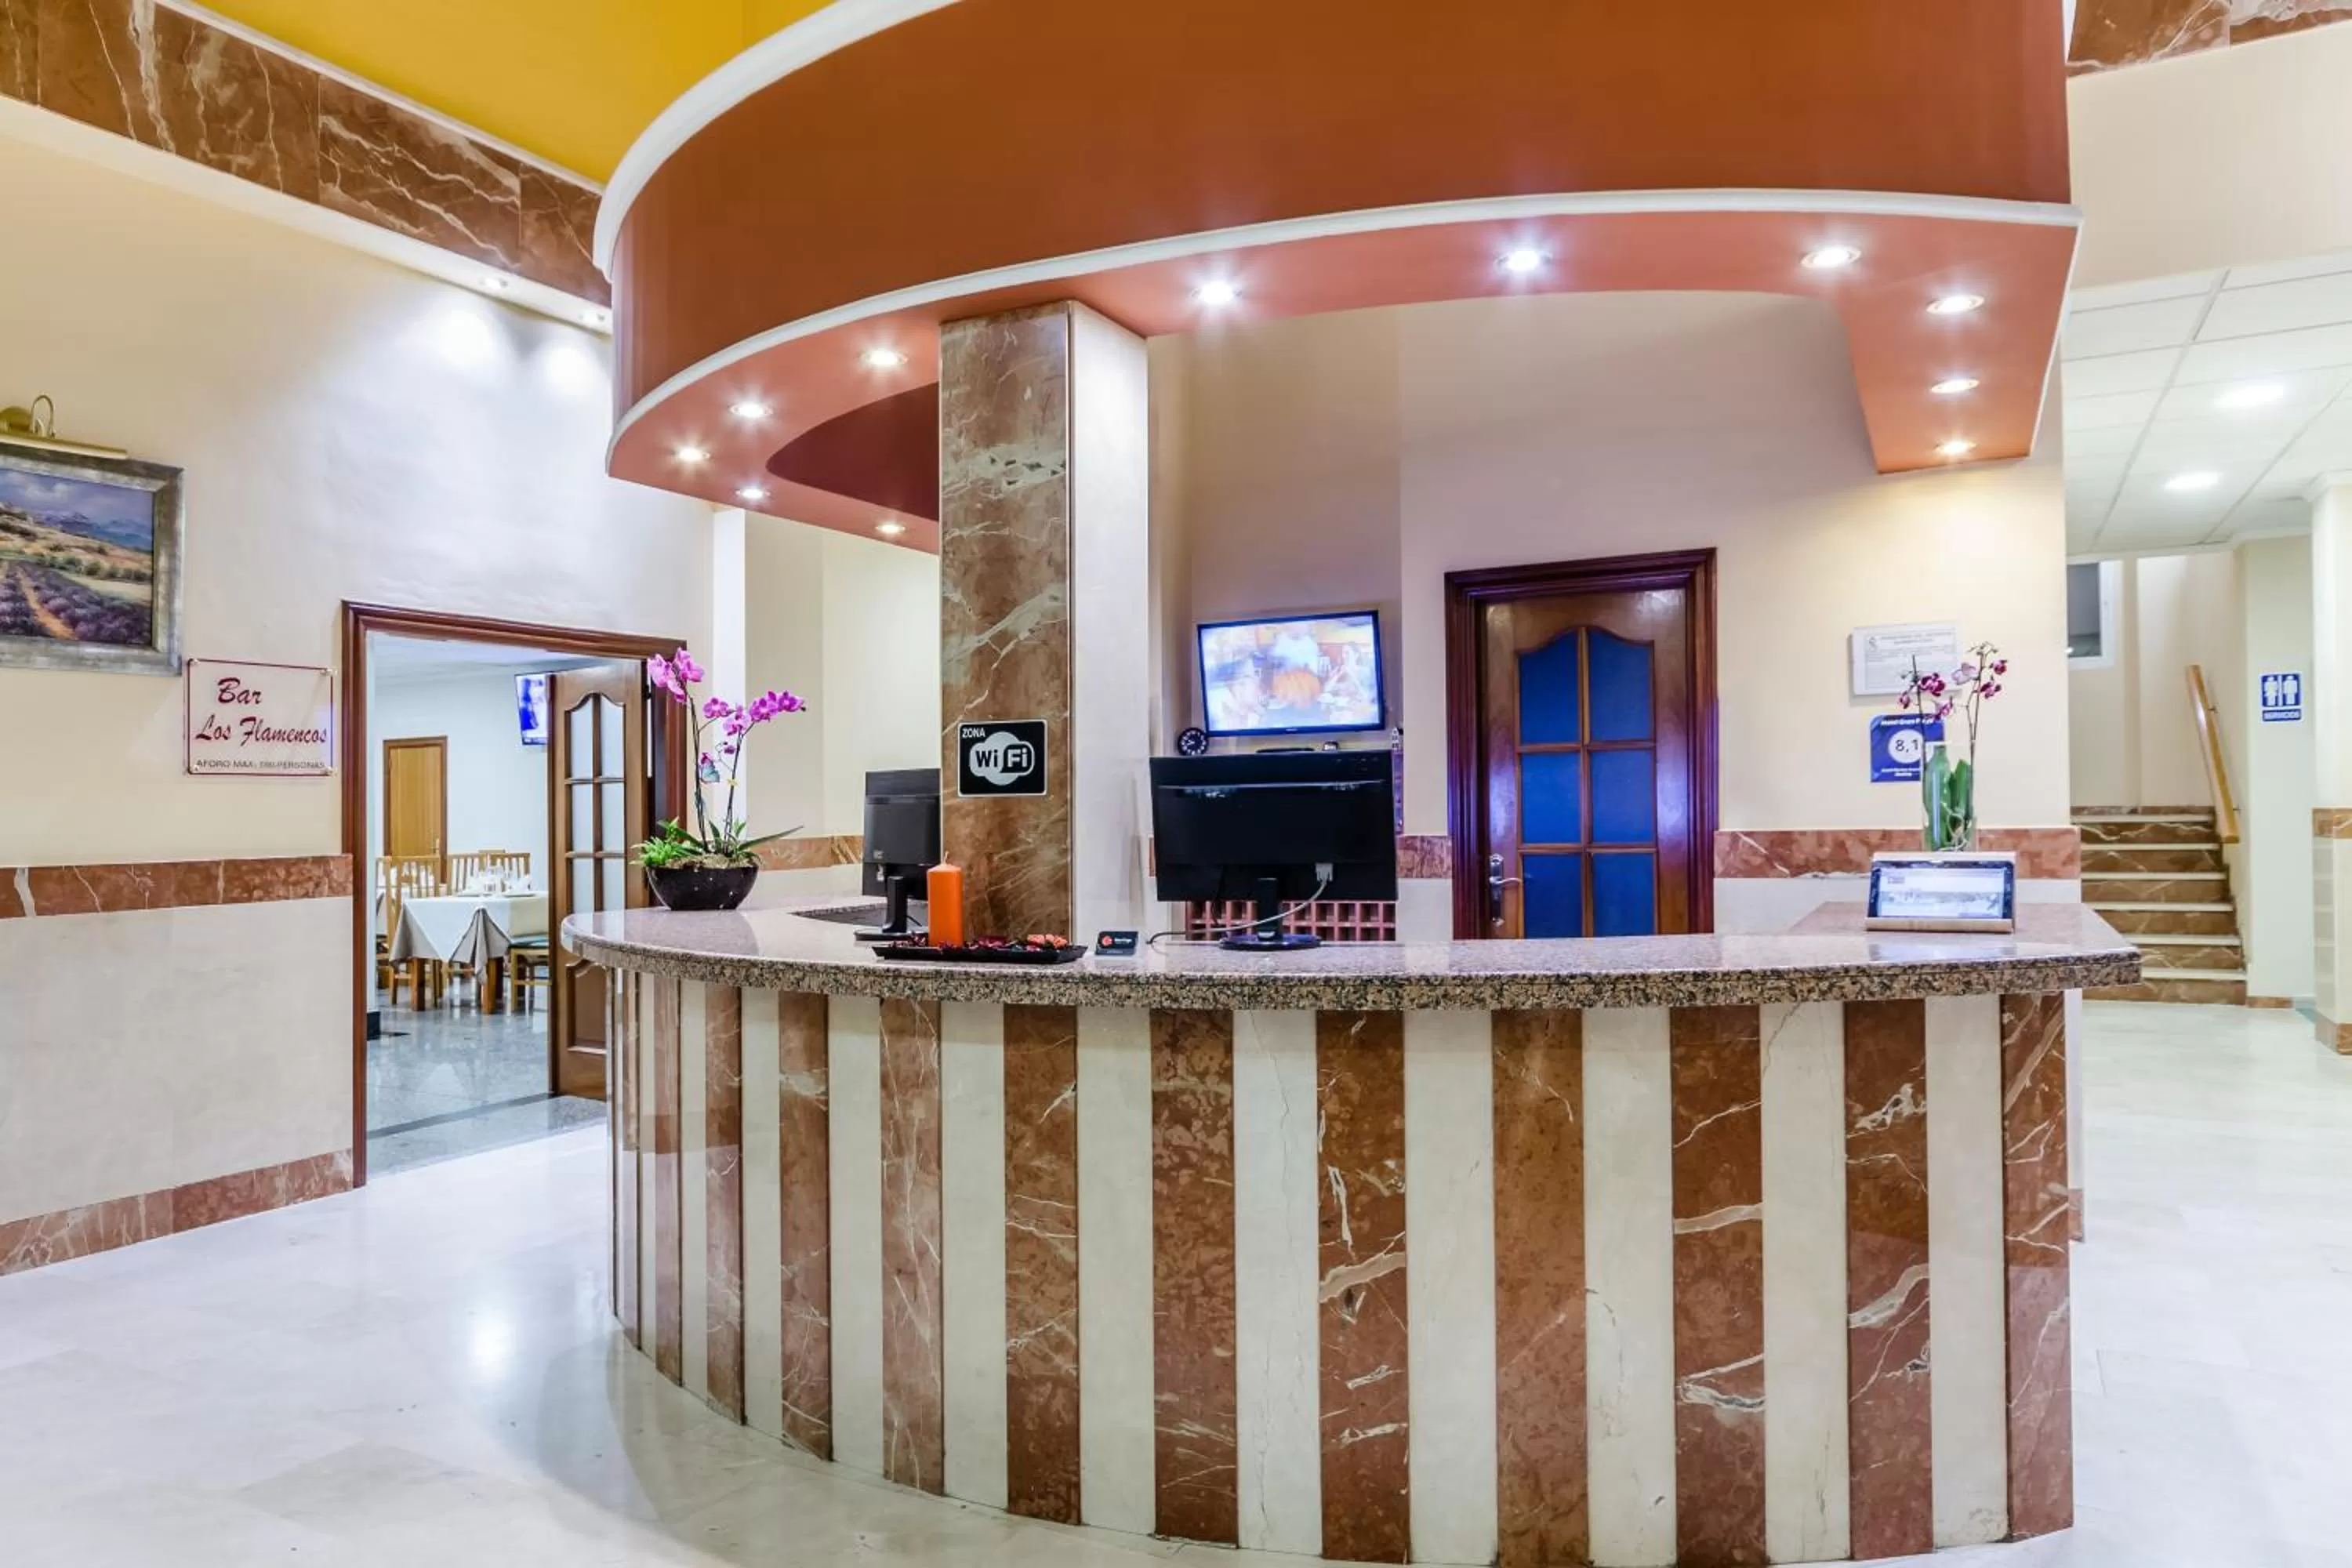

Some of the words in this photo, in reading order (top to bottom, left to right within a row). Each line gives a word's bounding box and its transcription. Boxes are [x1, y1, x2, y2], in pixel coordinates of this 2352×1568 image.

[217, 677, 263, 705] Bar
[195, 713, 231, 741] Los
[239, 716, 328, 747] Flamencos
[962, 728, 985, 739] ZONA
[1895, 739, 1918, 753] 8,1
